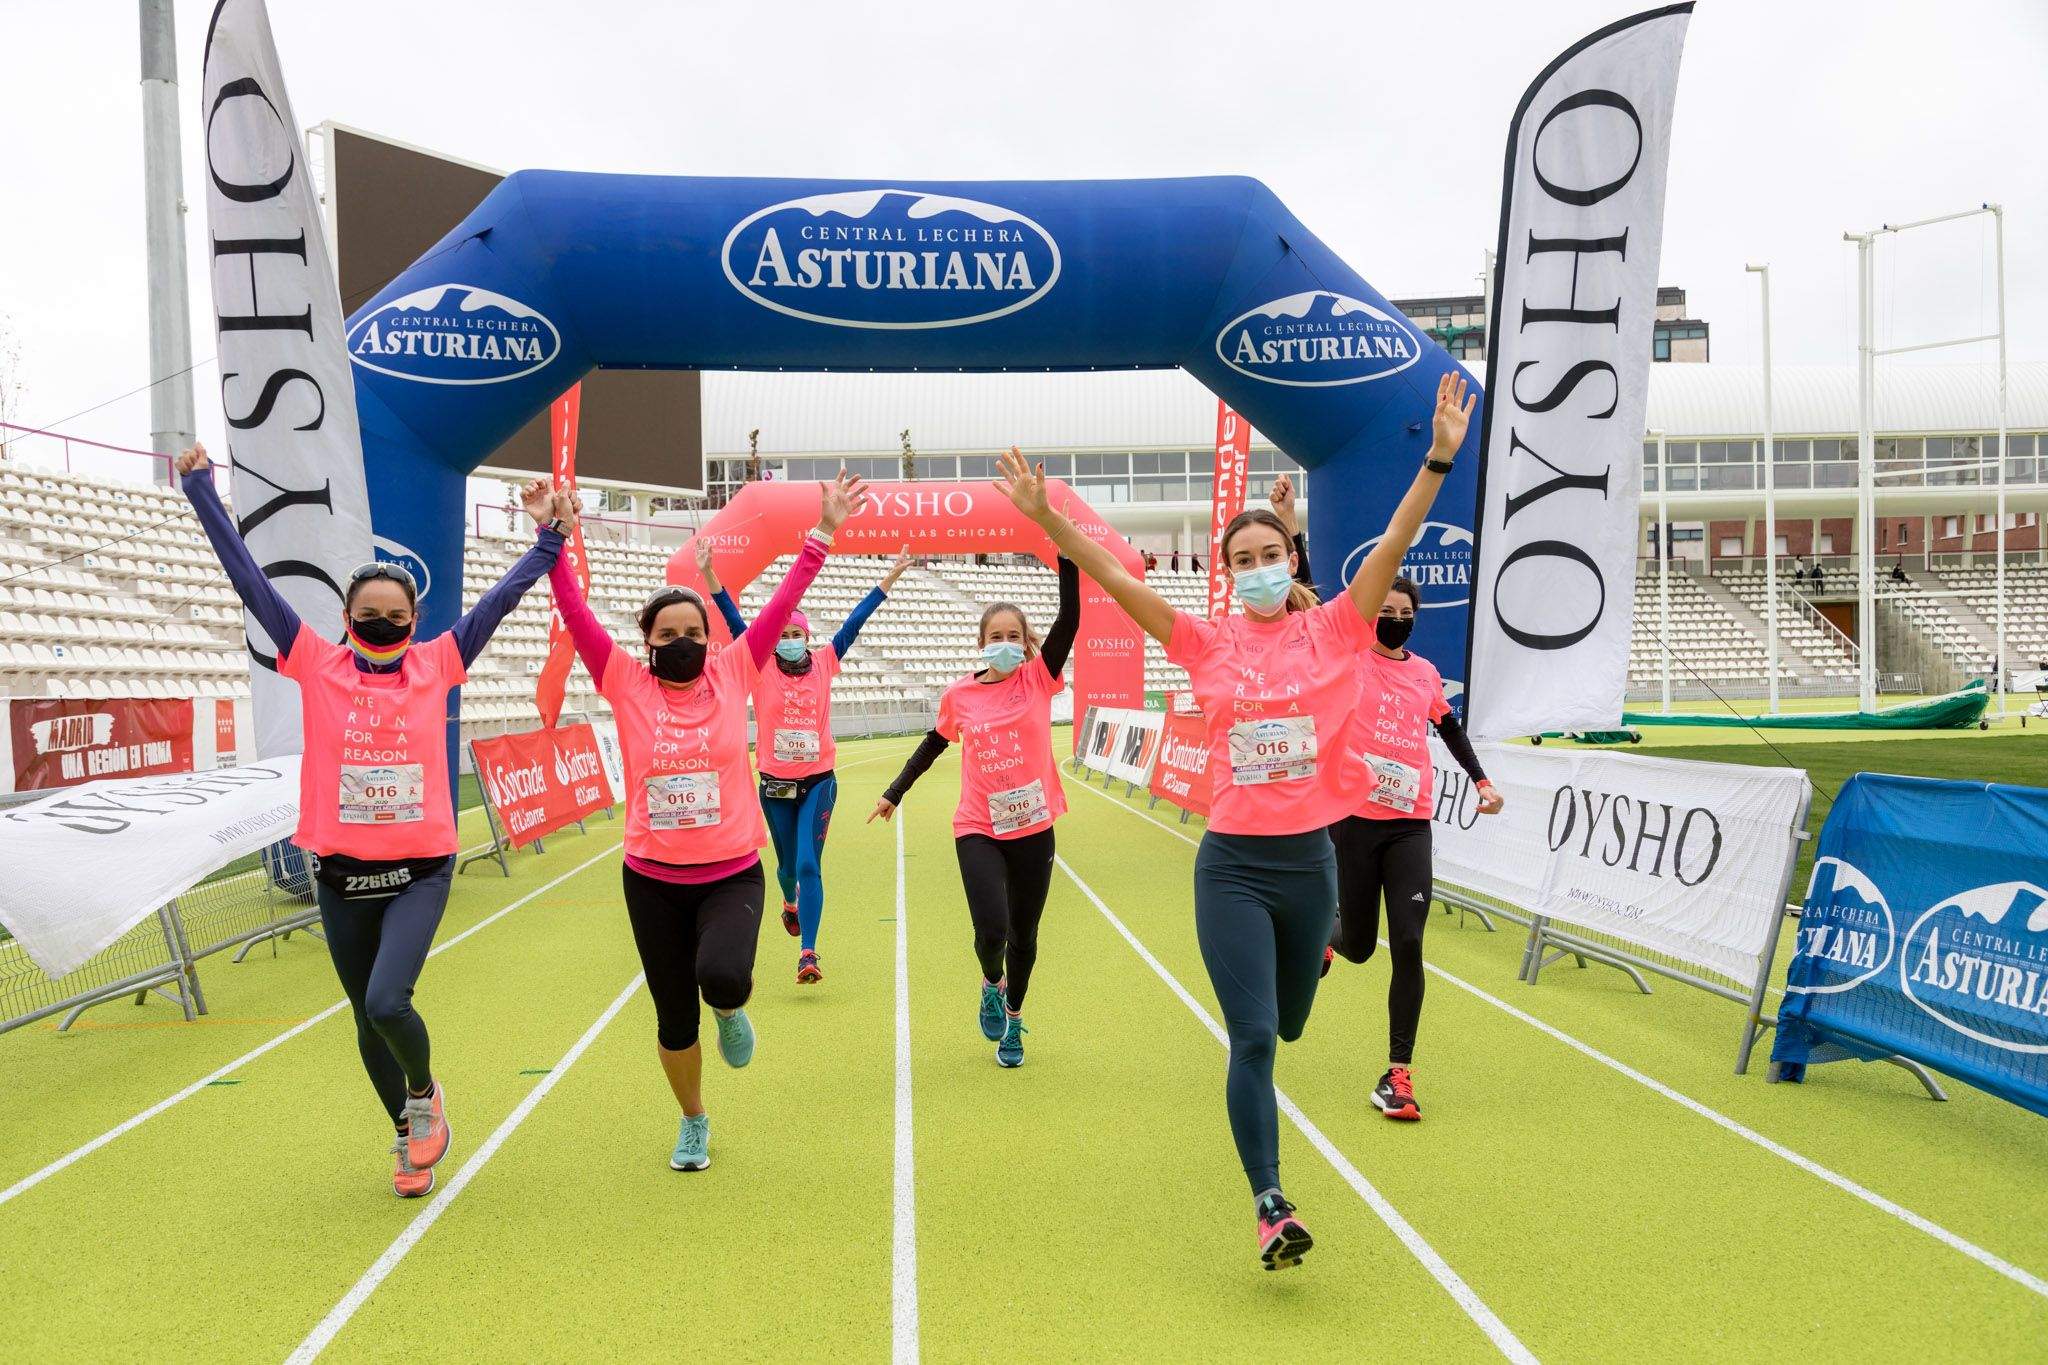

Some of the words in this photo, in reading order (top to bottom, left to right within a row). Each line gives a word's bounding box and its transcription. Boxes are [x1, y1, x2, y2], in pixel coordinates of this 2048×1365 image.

[802, 225, 906, 241] CENTRAL
[918, 228, 1024, 243] LECHERA
[747, 227, 1037, 290] ASTURIANA
[391, 316, 459, 328] CENTRAL
[466, 318, 539, 333] LECHERA
[1264, 322, 1332, 336] CENTRAL
[1339, 321, 1398, 334] LECHERA
[354, 320, 544, 362] ASTURIANA
[1232, 329, 1412, 364] ASTURIANA
[207, 76, 349, 673] OYSHO
[1493, 88, 1643, 651] OYSHO
[847, 490, 974, 518] OYSHO
[845, 529, 899, 538] GANAN
[909, 529, 938, 538] LAS
[946, 528, 1015, 538] CHICAS!
[1444, 551, 1471, 560] LECH
[1087, 638, 1135, 650] OYSHO
[1240, 667, 1265, 685] WE
[352, 695, 374, 709] WE
[1382, 692, 1400, 705] WE
[1233, 700, 1264, 713] FOR
[1288, 702, 1299, 713] A
[783, 717, 817, 726] REASON
[970, 723, 991, 735] WE
[1376, 719, 1398, 732] FOR
[48, 716, 95, 750] MADRID
[344, 729, 374, 744] FOR
[397, 732, 408, 744] A
[653, 743, 679, 754] FOR
[699, 741, 710, 753] A
[787, 740, 806, 749] 016
[1256, 741, 1289, 756] 016
[1374, 732, 1418, 751] REASON
[61, 752, 86, 779] UNA
[129, 745, 142, 770] EN
[143, 740, 173, 767] FORMA
[343, 747, 407, 762] REASON
[978, 749, 999, 761] FOR
[1013, 743, 1022, 753] A
[1167, 735, 1210, 775] Santander
[652, 758, 710, 771] REASON
[980, 756, 1024, 774] REASON
[1378, 774, 1401, 789] 016
[365, 785, 398, 798] 016
[667, 791, 696, 805] 016
[1008, 799, 1030, 812] 016
[1547, 784, 1722, 887] OYSHO
[344, 867, 413, 892] 226ERS
[1952, 928, 2021, 957] CENTRAL
